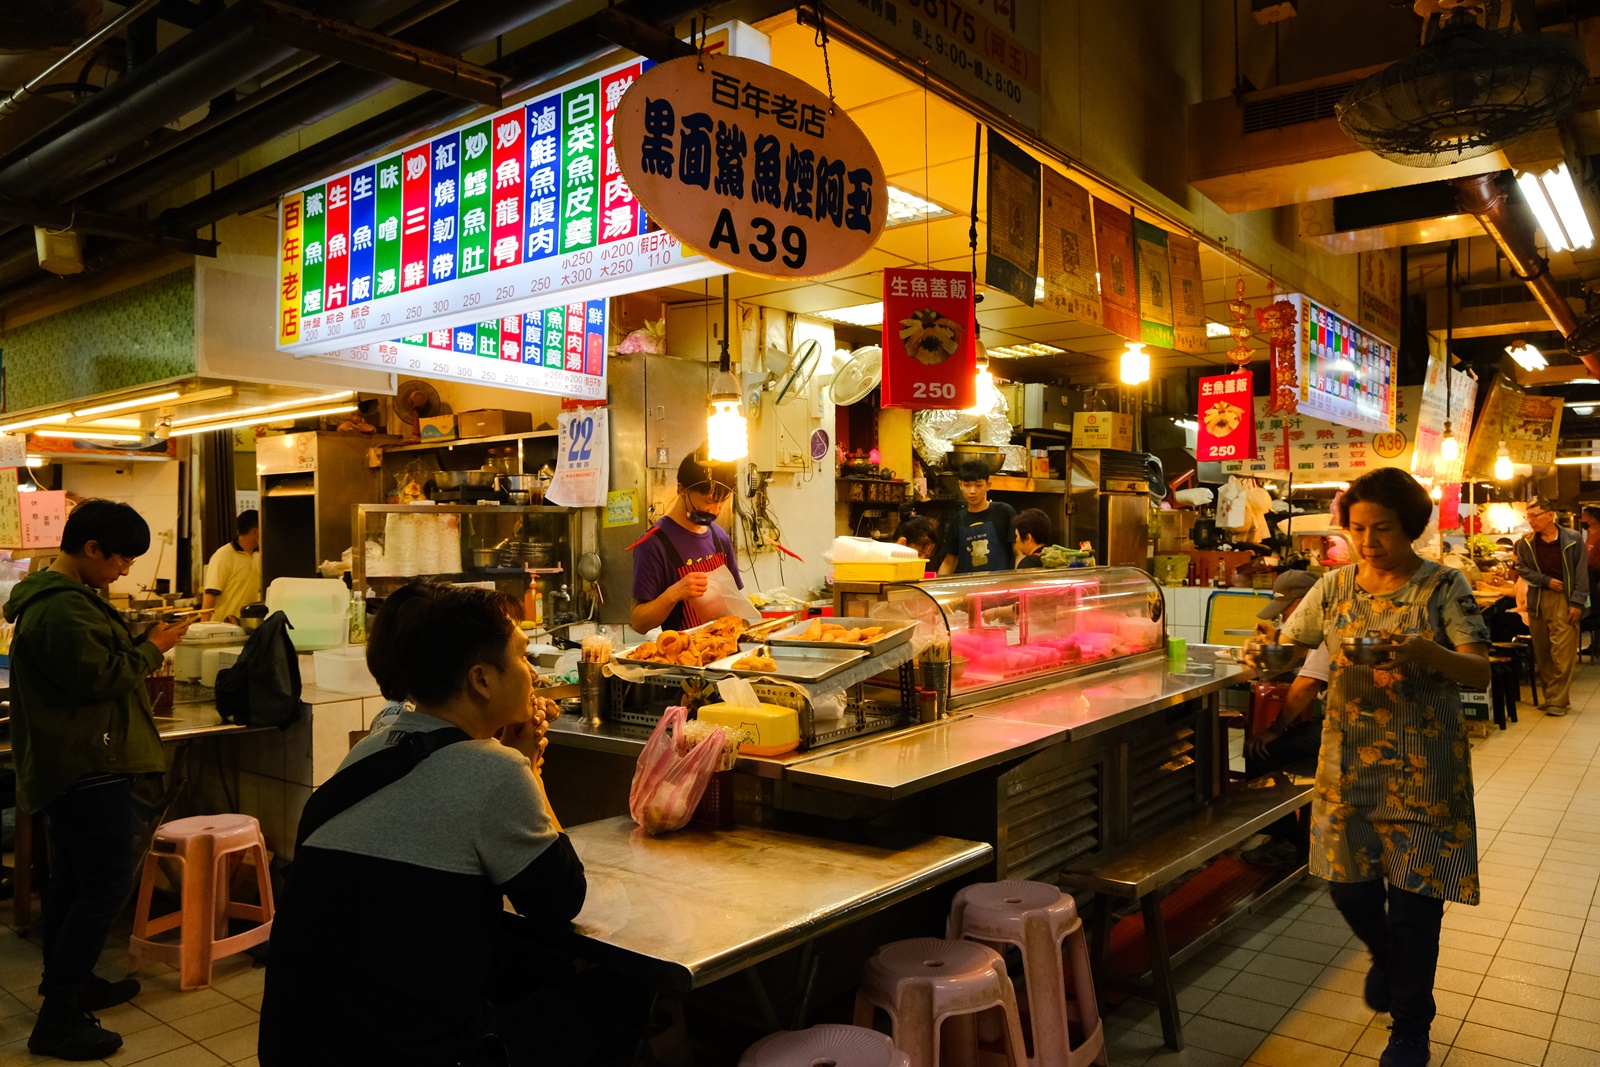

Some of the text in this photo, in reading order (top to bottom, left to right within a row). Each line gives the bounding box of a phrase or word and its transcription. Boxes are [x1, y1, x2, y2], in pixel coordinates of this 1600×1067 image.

[909, 0, 976, 44] 8175
[711, 70, 826, 138] 百年老店
[564, 92, 595, 248] 白菜魚皮羹
[528, 105, 557, 259] 滷鮭魚腹肉
[494, 119, 521, 267] 炒魚龍骨
[461, 132, 488, 273] 炒鱈魚肚
[376, 164, 399, 296] 味噌湯
[403, 154, 427, 288] 炒三鮮
[326, 185, 348, 308] 生魚片
[351, 175, 373, 302] 生魚飯
[709, 208, 807, 269] A39
[303, 192, 324, 313] 鯊魚煙
[562, 250, 593, 270] 小250
[601, 241, 634, 262] 小200
[648, 250, 671, 267] 110
[281, 201, 300, 338] 百年老店
[561, 267, 593, 286] 大300
[600, 258, 633, 277] 大250
[496, 285, 515, 301] 250
[531, 276, 551, 292] 250
[891, 276, 967, 299] 生魚蓋飯
[433, 299, 449, 314] 300
[463, 292, 481, 307] 250
[380, 313, 391, 325] 20
[406, 306, 422, 320] 250
[327, 324, 340, 336] 300
[353, 319, 366, 331] 120
[305, 329, 319, 341] 200
[546, 306, 563, 367] 魚皮羹
[350, 350, 368, 361] 300
[382, 354, 397, 365] 120
[410, 359, 420, 369] 20
[433, 363, 449, 373] 250
[457, 367, 473, 377] 300
[482, 371, 496, 381] 250
[504, 374, 519, 385] 250
[1201, 378, 1247, 396] 生魚蓋飯
[913, 382, 956, 399] 250
[568, 416, 594, 461] 22
[1378, 436, 1402, 451] A36
[1209, 445, 1236, 457] 250
